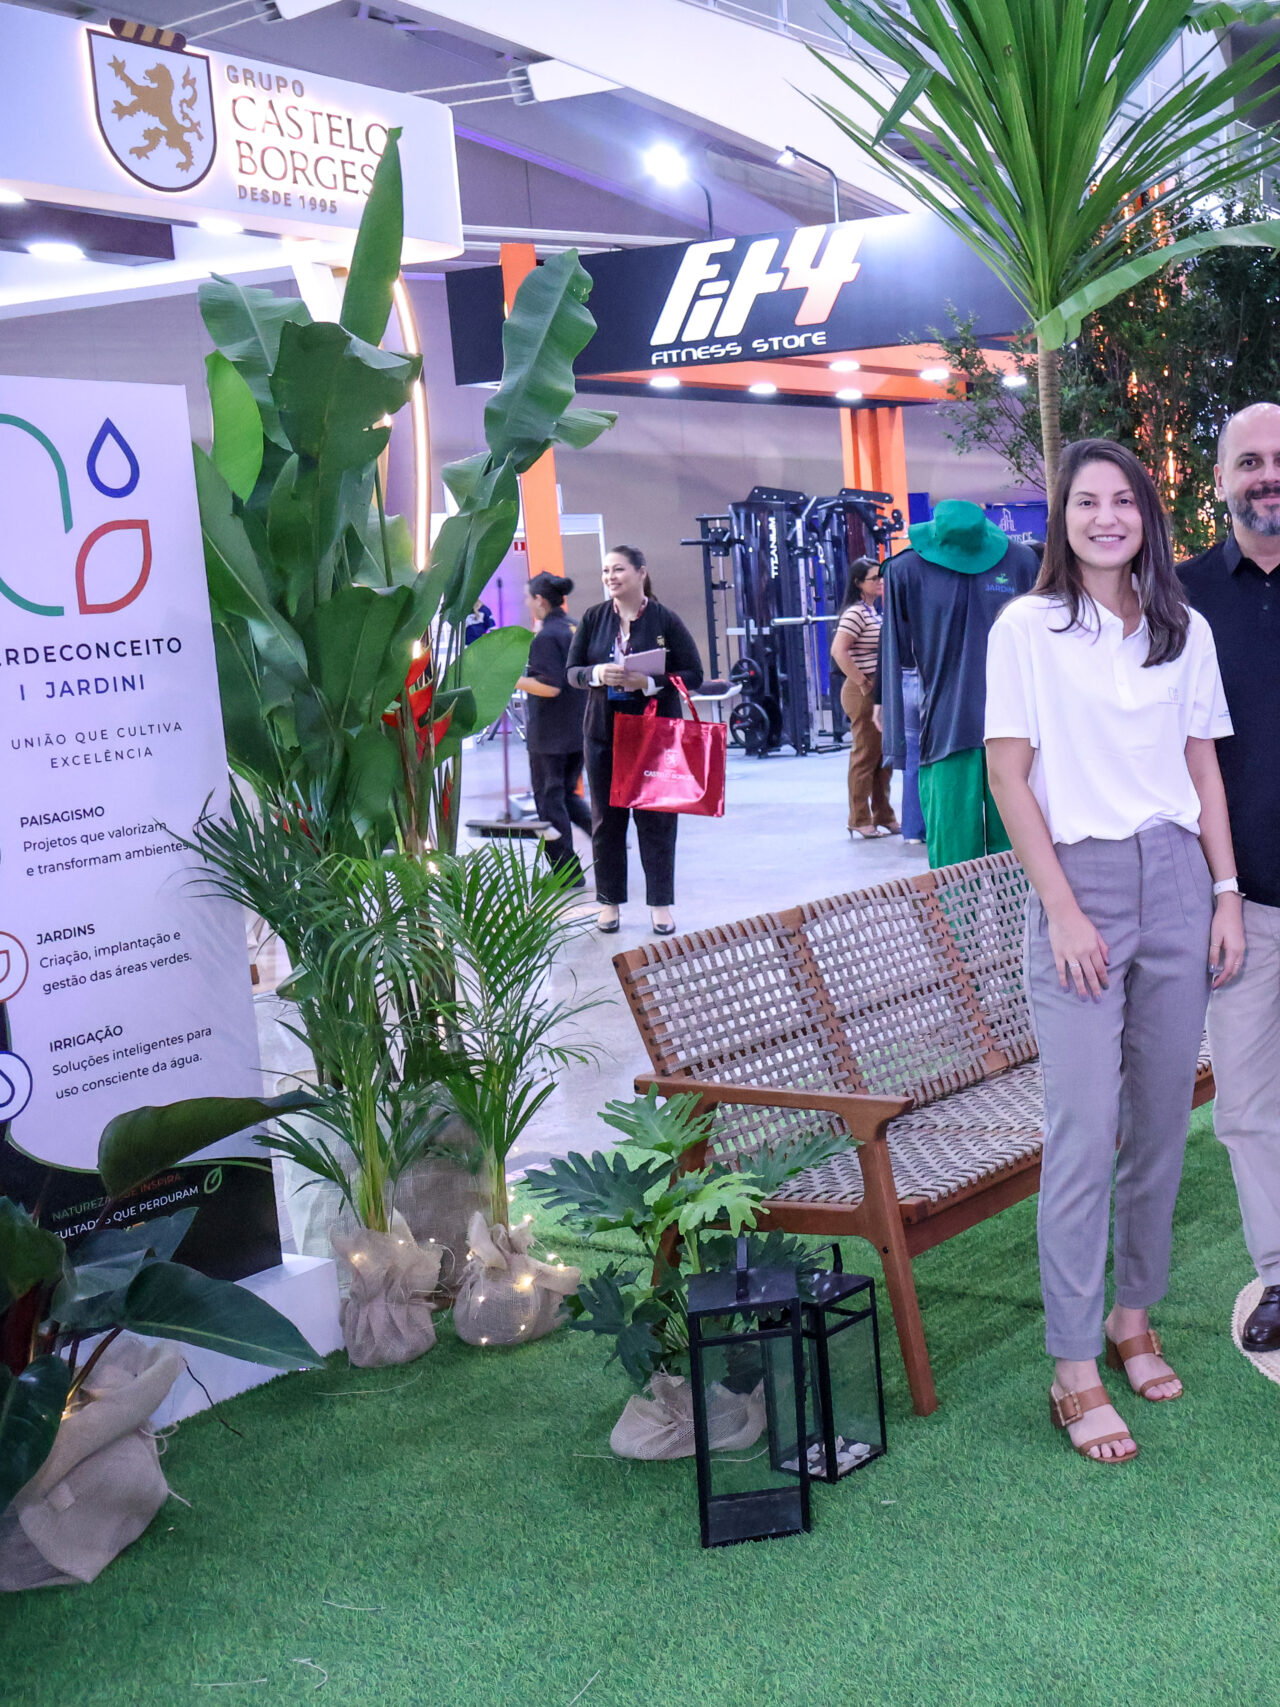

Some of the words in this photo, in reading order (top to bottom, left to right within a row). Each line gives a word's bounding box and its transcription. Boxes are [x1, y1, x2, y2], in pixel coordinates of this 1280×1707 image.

[226, 64, 305, 98] GRUPO
[231, 96, 389, 158] CASTELO
[235, 139, 374, 197] BORGES
[238, 184, 292, 207] DESDE
[299, 194, 338, 214] 1995
[752, 331, 827, 353] STORE
[0, 637, 182, 667] RDECONCEITO
[46, 674, 145, 699] JARDINI
[11, 732, 67, 750] UNIÃO
[75, 729, 109, 744] QUE
[116, 721, 183, 738] CULTIVA
[50, 746, 153, 769] EXCELÊNCIA
[20, 806, 105, 828] PAISAGISMO
[23, 836, 77, 853] Projetos
[80, 831, 105, 846] que
[108, 820, 167, 840] valorizam
[26, 866, 34, 877] e
[37, 851, 122, 875] transformam
[36, 923, 96, 946] JARDINS
[39, 948, 92, 971] Criação,
[94, 931, 171, 960] implantação
[173, 931, 181, 942] e
[42, 972, 87, 995] gestão
[89, 968, 112, 982] das
[115, 961, 148, 977] áreas
[150, 951, 193, 970] verdes.
[49, 1023, 124, 1053] IRRIGAÇÃO
[52, 1052, 110, 1077] Soluções
[112, 1035, 184, 1062] inteligentes
[186, 1026, 213, 1044] para
[55, 1083, 79, 1100] uso
[81, 1068, 150, 1092] consciente
[152, 1059, 168, 1073] da
[170, 1053, 203, 1070] água.
[113, 1206, 136, 1221] QUE
[139, 1185, 199, 1213] PERDURAM
